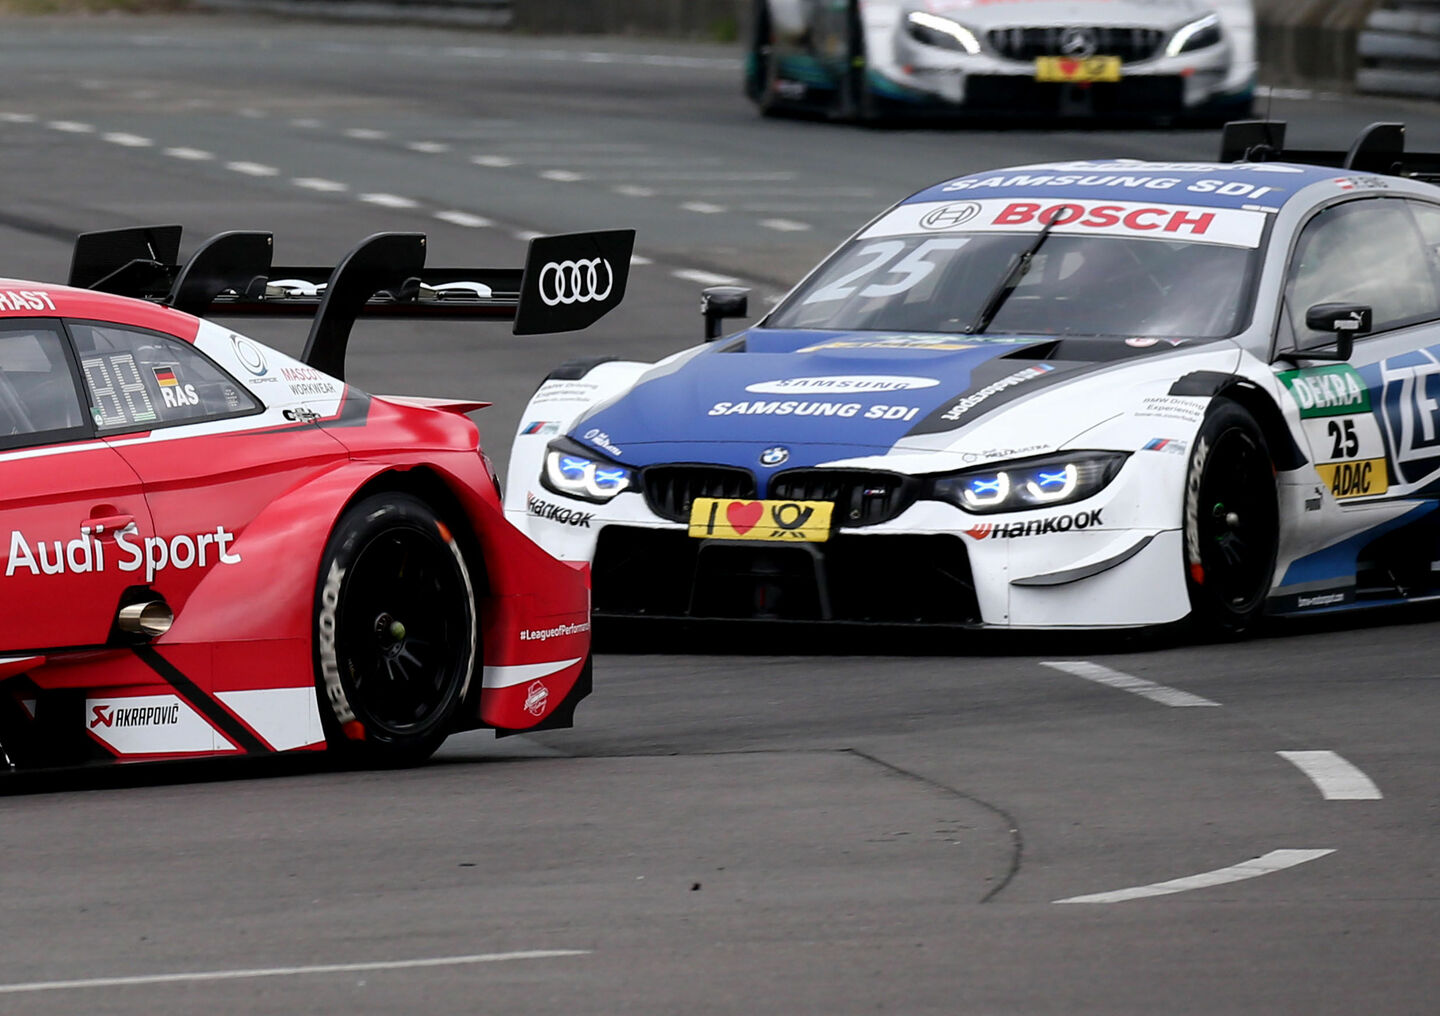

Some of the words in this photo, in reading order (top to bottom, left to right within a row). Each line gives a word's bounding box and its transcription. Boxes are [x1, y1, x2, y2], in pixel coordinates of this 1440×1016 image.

[941, 175, 1182, 193] SAMSUNG
[1187, 179, 1273, 199] SDI
[992, 201, 1216, 235] BOSCH
[802, 238, 972, 306] 25
[280, 367, 322, 382] MASCOT
[775, 379, 911, 390] SAMSUNG
[160, 384, 200, 409] RAS
[289, 383, 337, 396] WORKWEAR
[1291, 372, 1363, 410] DEKRA
[708, 400, 862, 418] SAMSUNG
[864, 405, 921, 421] SDI
[1146, 403, 1201, 417] Experience
[1170, 398, 1205, 411] Driving
[1328, 419, 1359, 459] 25
[1331, 461, 1372, 496] ADAC
[707, 502, 719, 535] I
[5, 524, 105, 576] Audi
[113, 522, 242, 583] Sport
